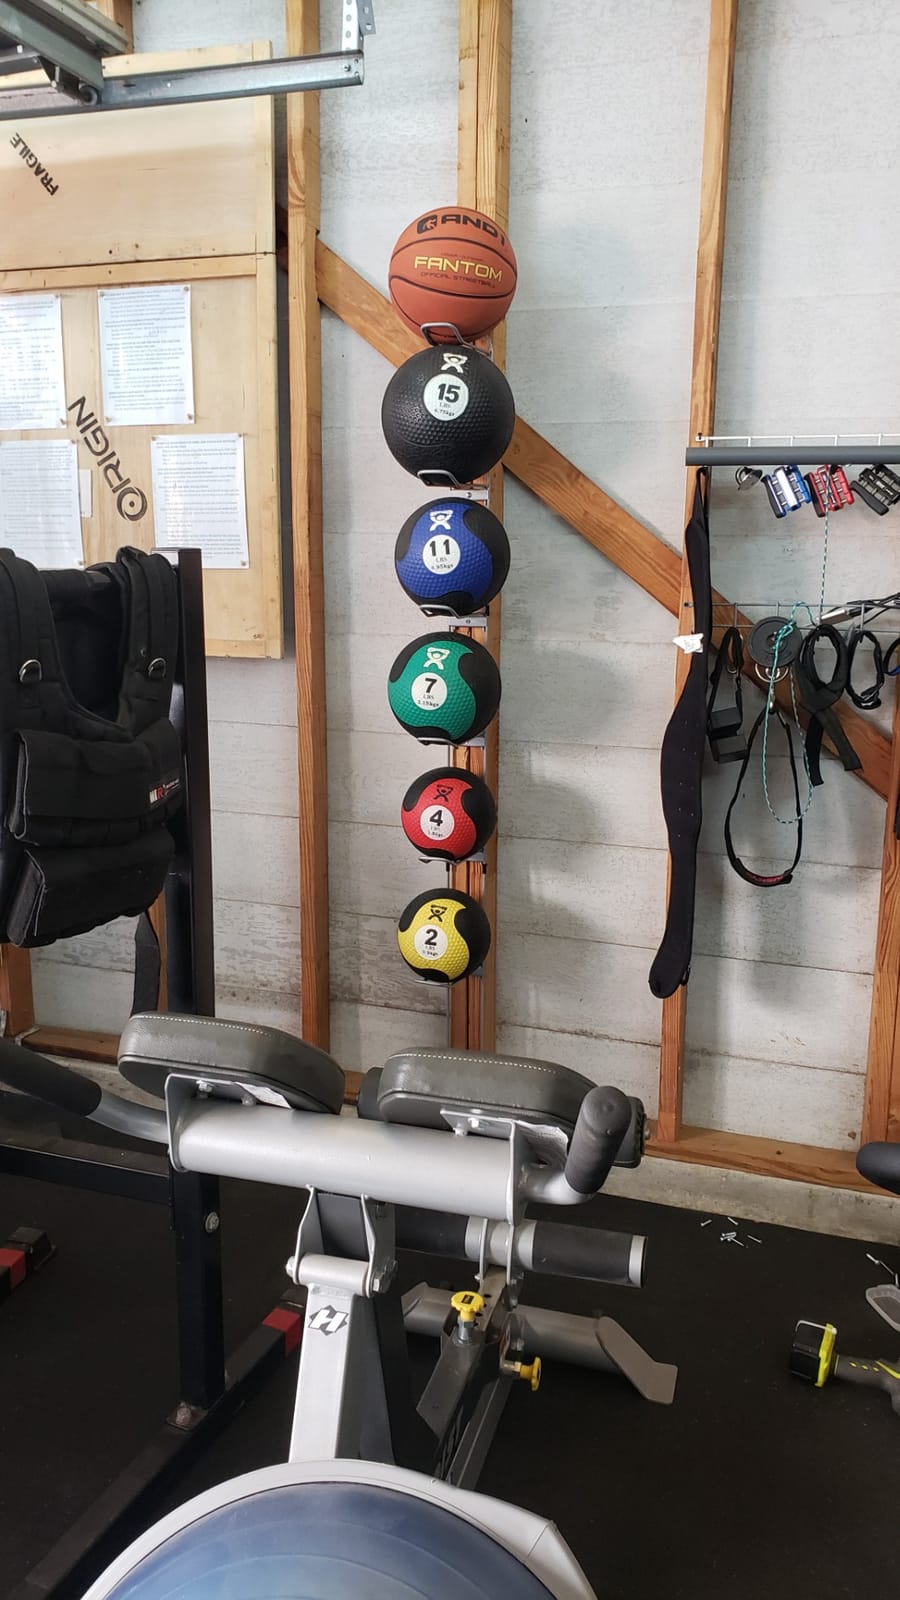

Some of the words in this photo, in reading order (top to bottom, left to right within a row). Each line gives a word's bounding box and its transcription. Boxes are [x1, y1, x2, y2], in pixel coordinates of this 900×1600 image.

[9, 132, 59, 196] FRAGILE
[414, 256, 502, 281] FANTOM
[438, 383, 461, 403] 15
[67, 395, 148, 522] ORIGIN
[429, 539, 451, 557] 11
[425, 678, 438, 693] 7
[429, 809, 444, 827] 4
[424, 928, 438, 947] 2
